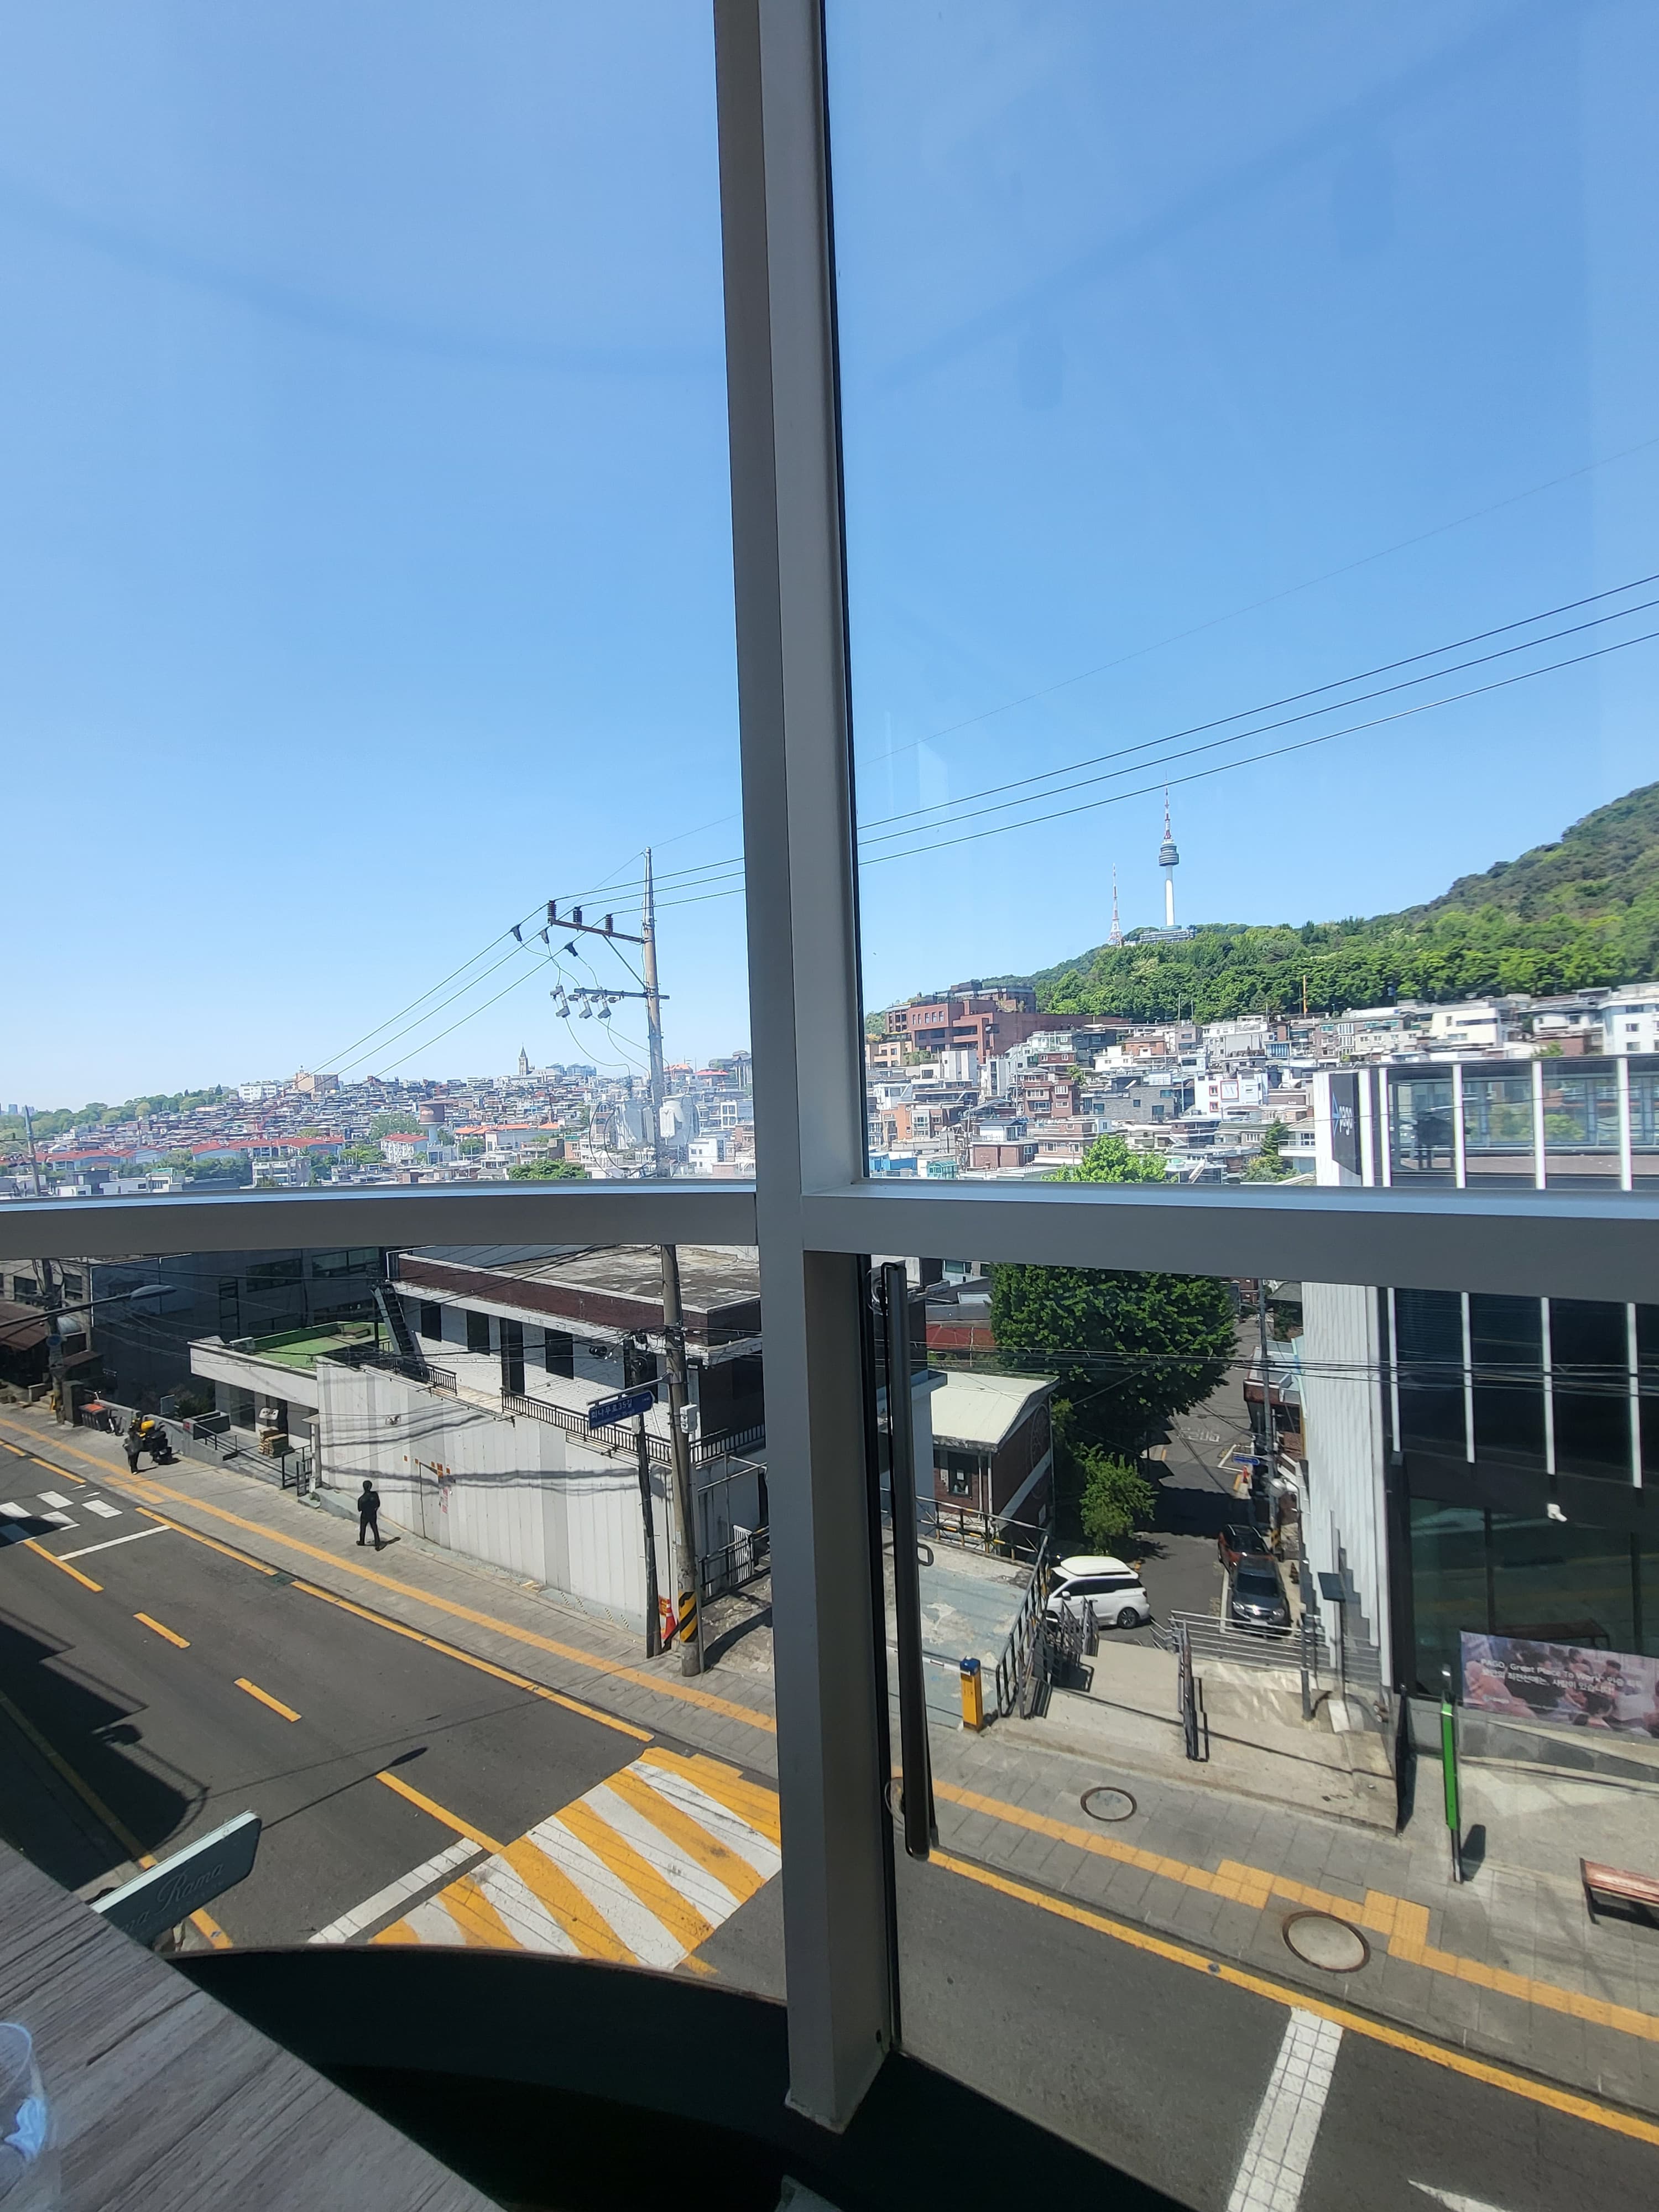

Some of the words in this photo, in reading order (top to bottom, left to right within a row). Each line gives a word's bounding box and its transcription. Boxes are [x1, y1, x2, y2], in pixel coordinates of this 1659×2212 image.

[1339, 1105, 1353, 1136] pago
[591, 1399, 632, 1419] 회나무로35길
[1510, 1663, 1535, 1673] Great
